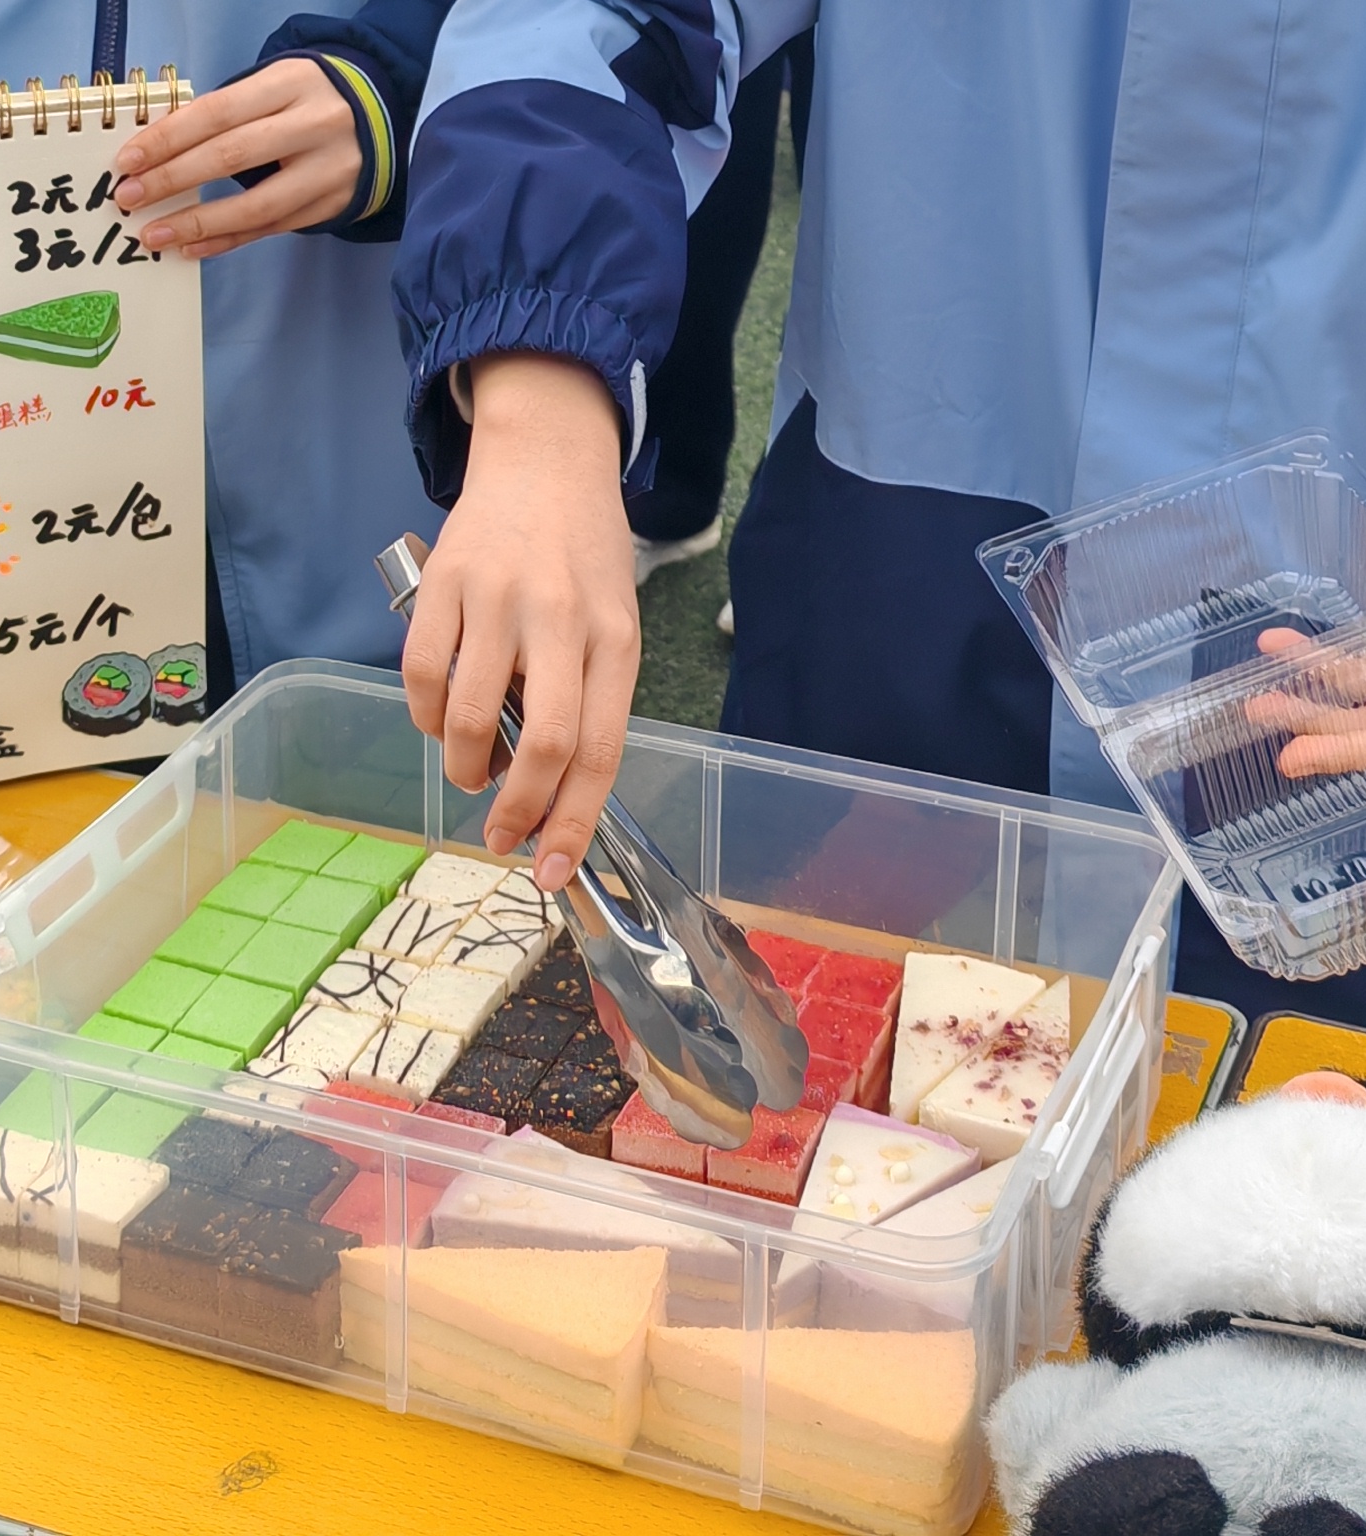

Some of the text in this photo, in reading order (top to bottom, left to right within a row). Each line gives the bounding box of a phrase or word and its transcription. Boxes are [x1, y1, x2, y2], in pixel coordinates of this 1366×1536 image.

[14, 222, 161, 273] 3元/2
[84, 378, 155, 414] 10元
[32, 482, 172, 544] 2元/包
